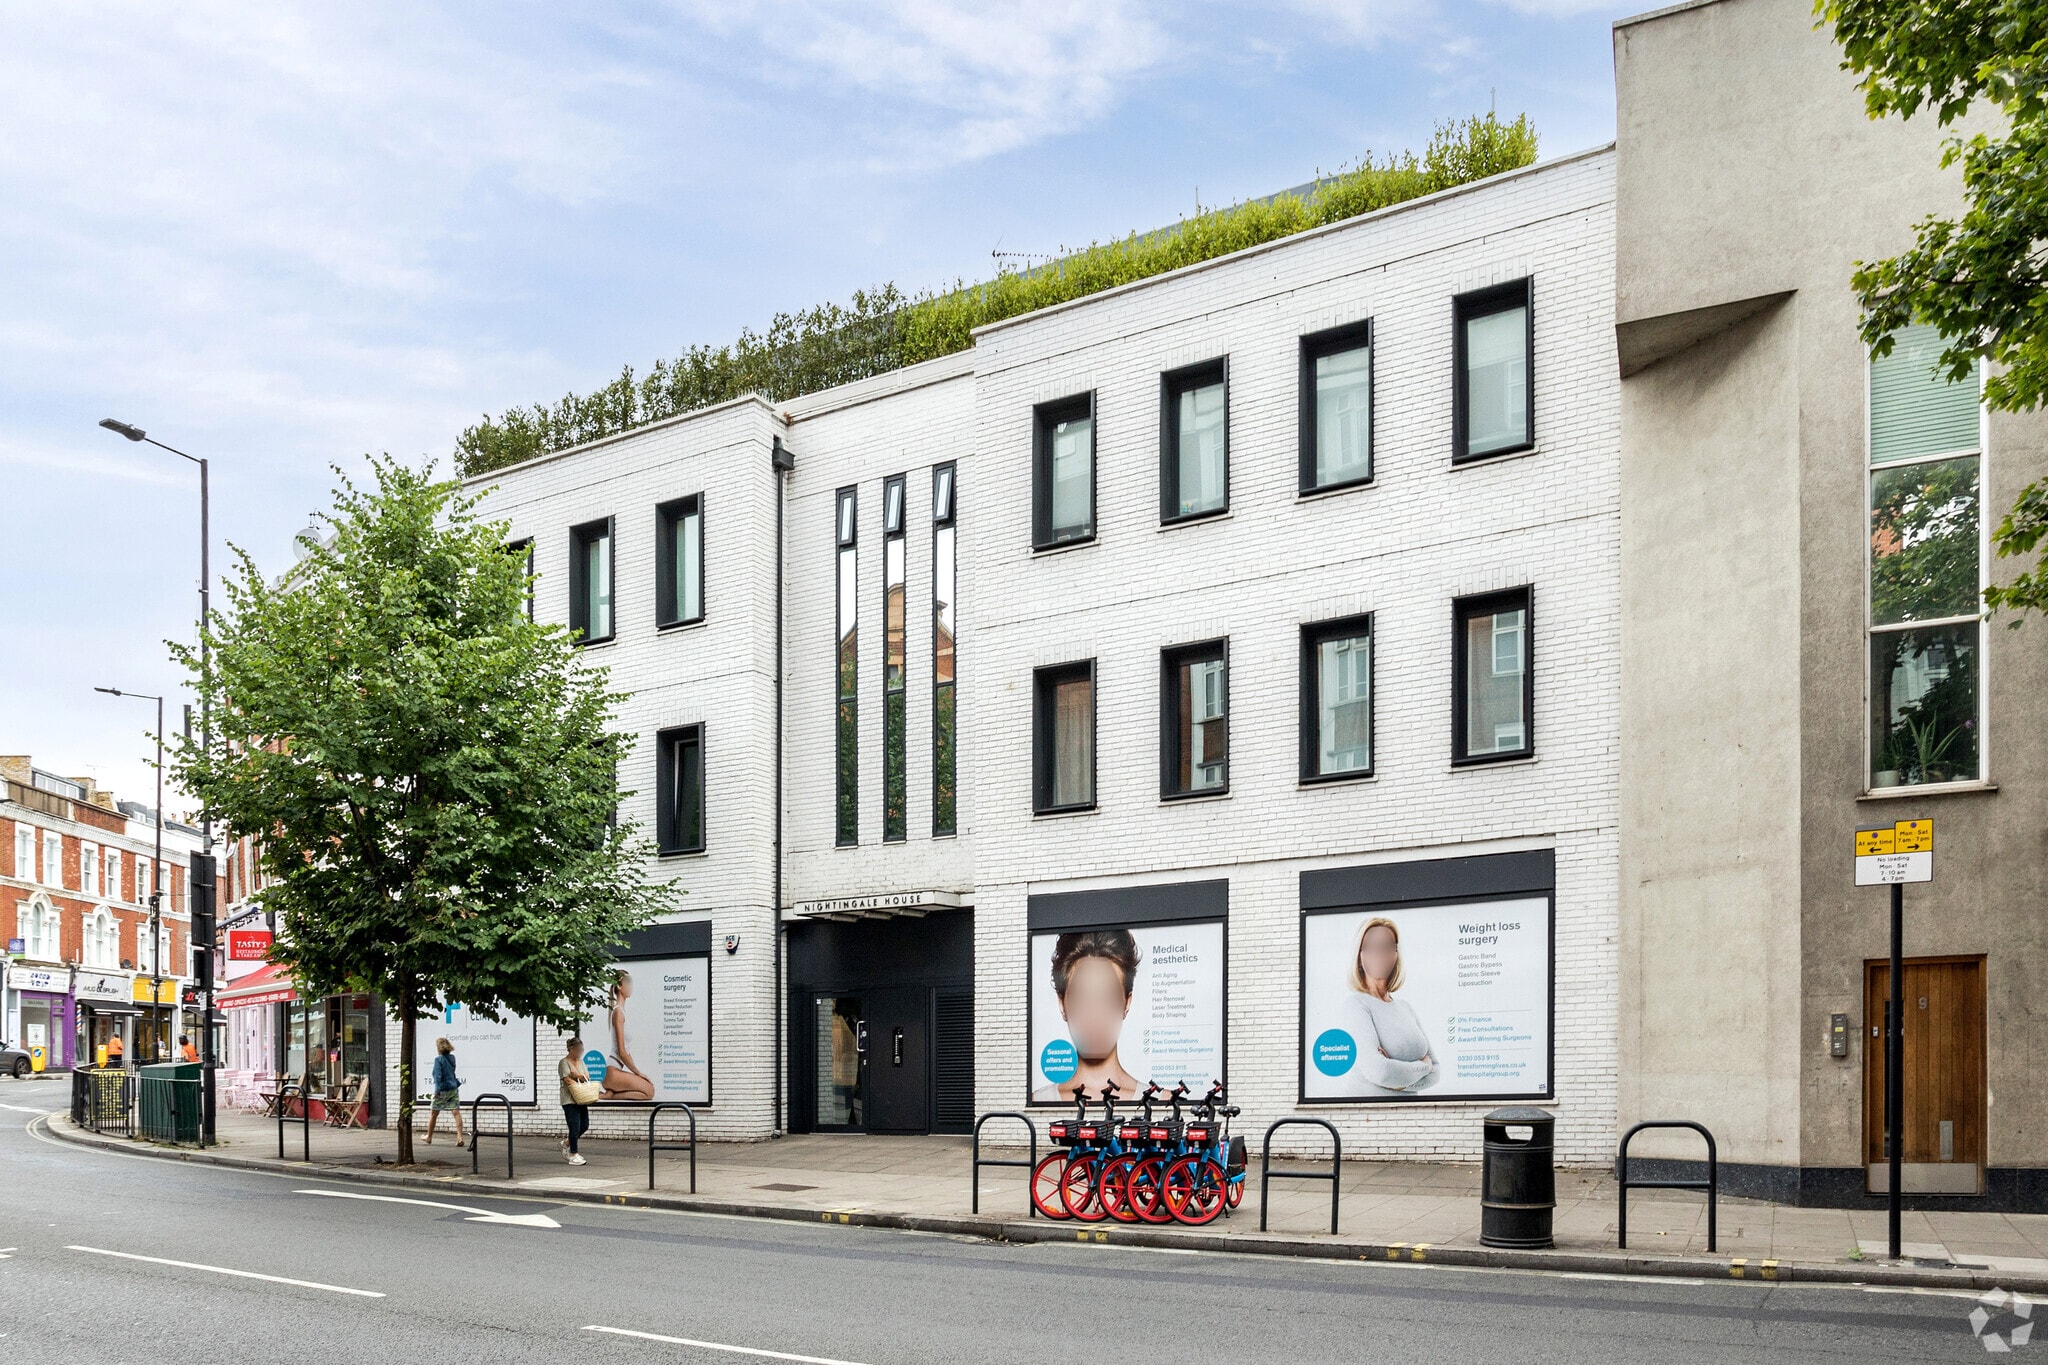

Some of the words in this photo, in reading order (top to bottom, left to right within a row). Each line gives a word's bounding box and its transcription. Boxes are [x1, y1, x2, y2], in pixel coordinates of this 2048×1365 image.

[804, 898, 877, 912] NIGHTINGALE
[885, 894, 921, 905] HOUSE
[1458, 922, 1496, 934] Weight
[1498, 922, 1521, 931] loss
[1458, 935, 1498, 946] surgery
[1152, 944, 1188, 954] Medical
[1152, 954, 1198, 964] aesthetics
[446, 1034, 468, 1042] Expertise
[469, 1034, 479, 1042] you
